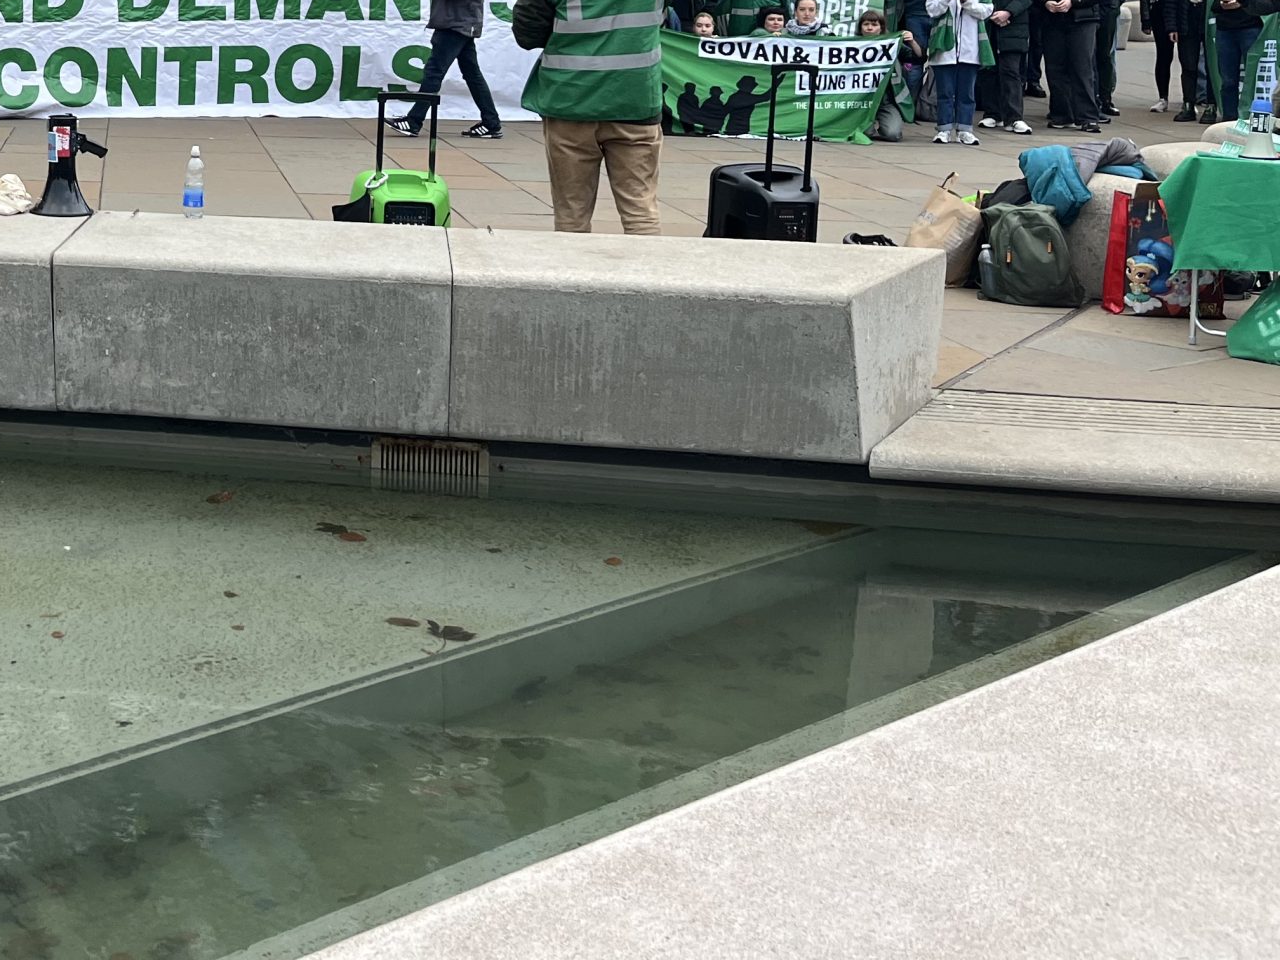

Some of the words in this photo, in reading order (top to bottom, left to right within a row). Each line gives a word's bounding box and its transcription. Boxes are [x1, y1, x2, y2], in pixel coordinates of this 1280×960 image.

[700, 40, 789, 64] GOVAN
[817, 42, 896, 65] IBROX
[824, 101, 833, 110] OF
[834, 101, 846, 110] THE
